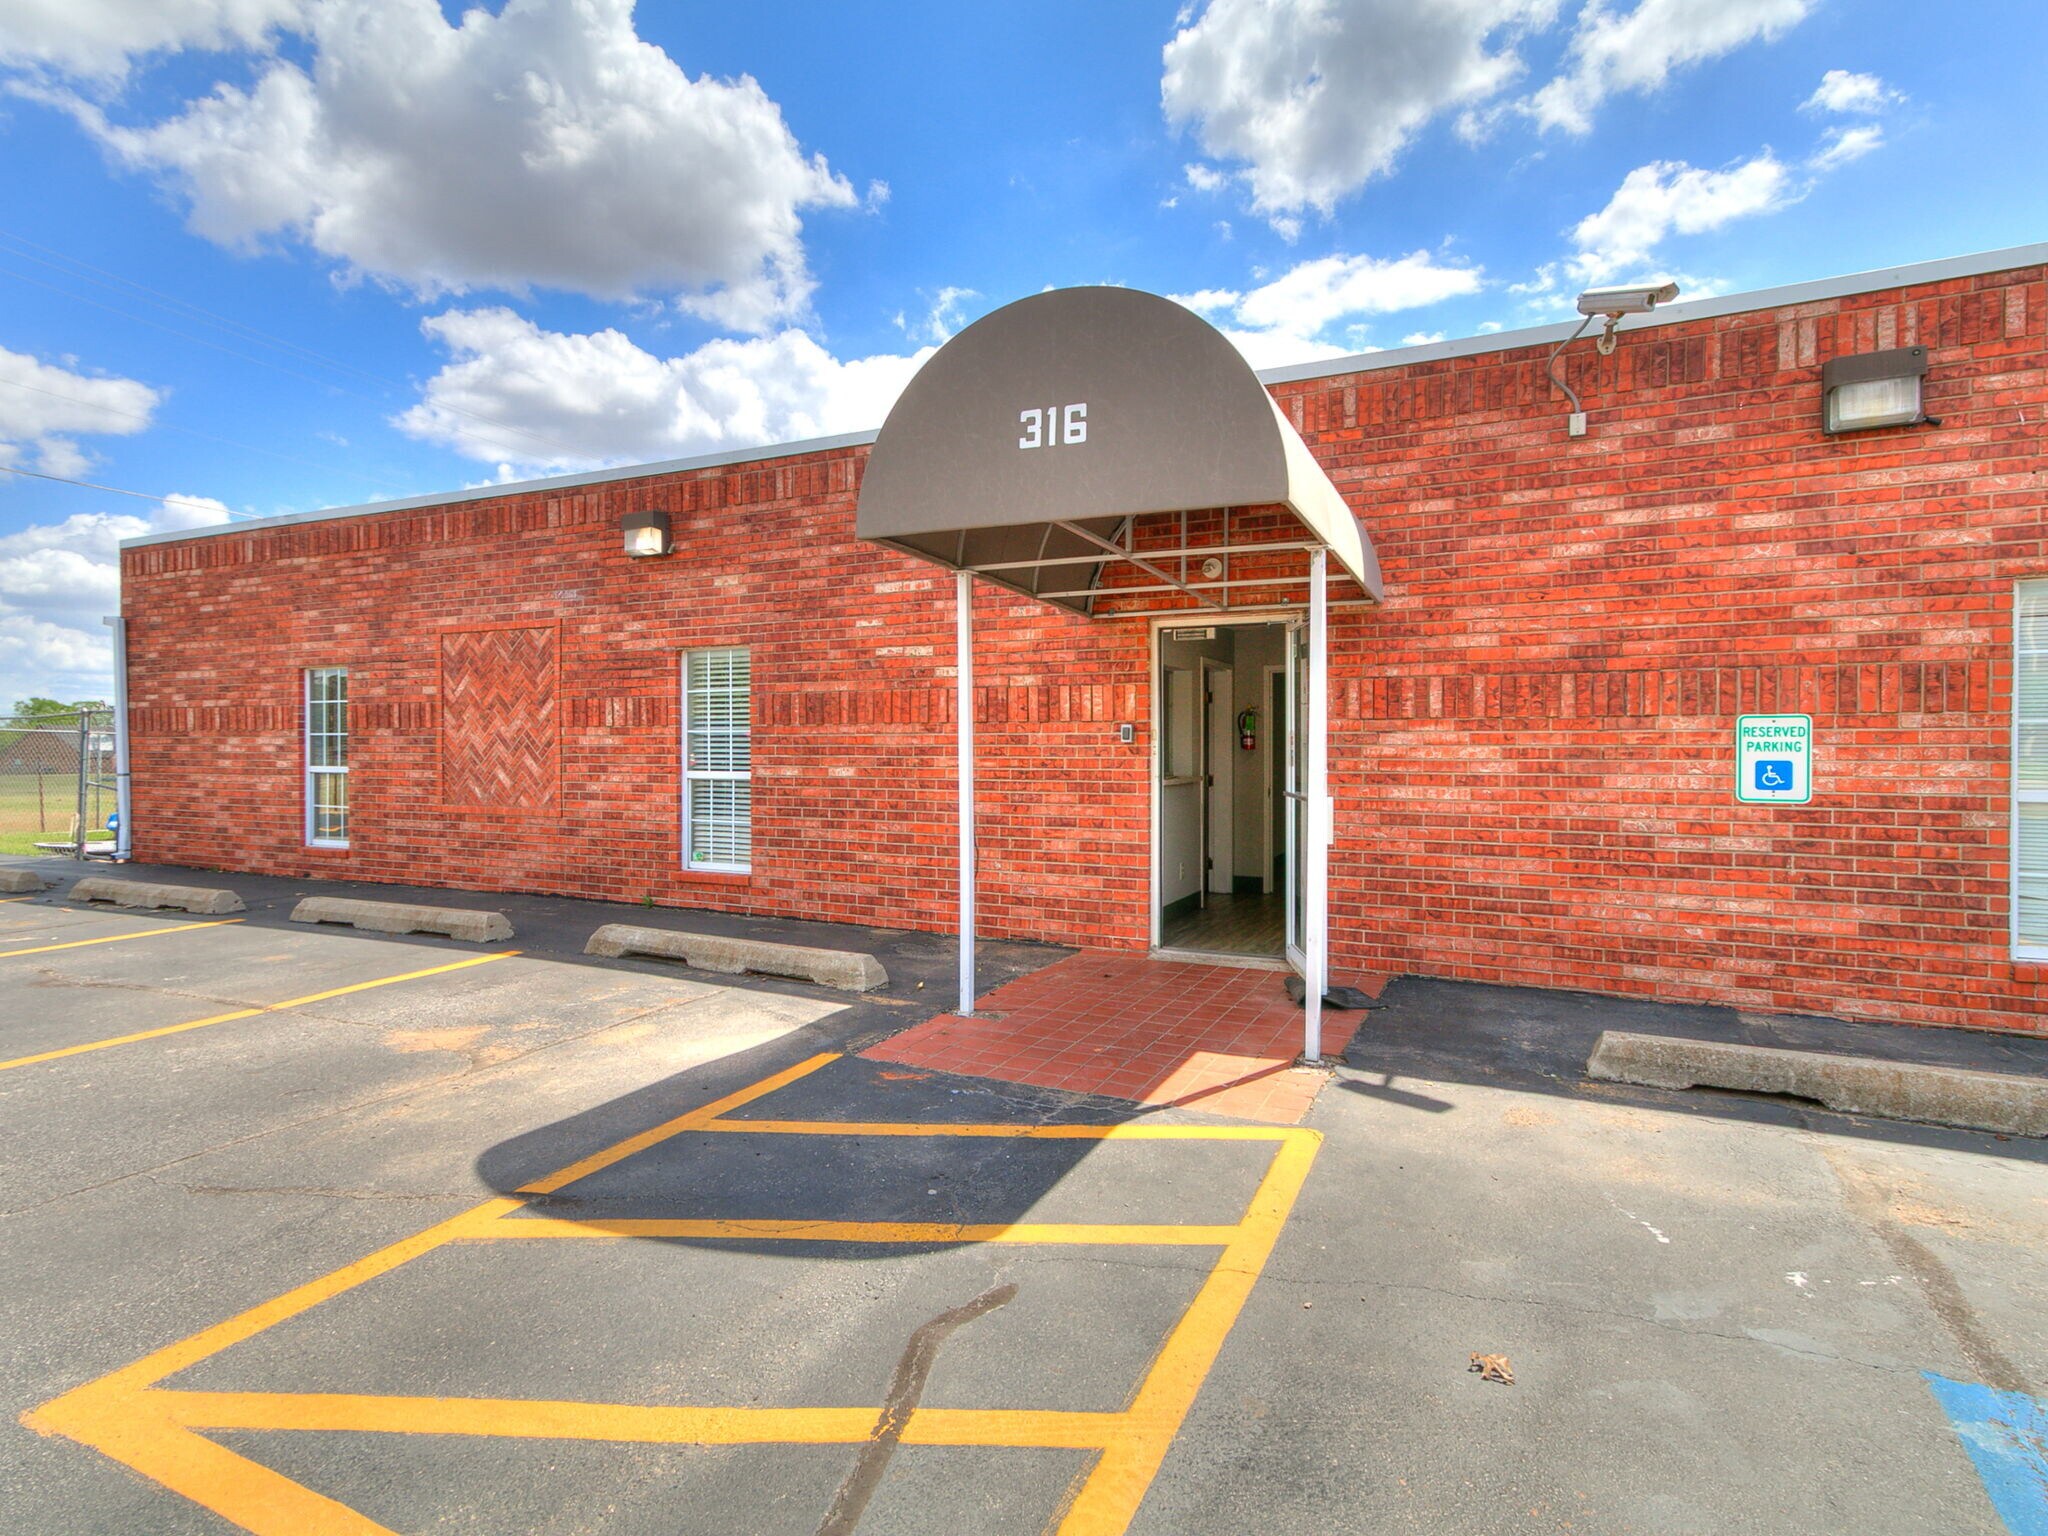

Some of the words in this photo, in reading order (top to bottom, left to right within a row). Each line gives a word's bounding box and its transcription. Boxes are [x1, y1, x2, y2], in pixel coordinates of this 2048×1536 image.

[1019, 403, 1087, 449] 316
[1743, 726, 1806, 737] RESERVED
[1746, 741, 1802, 752] PARKING
